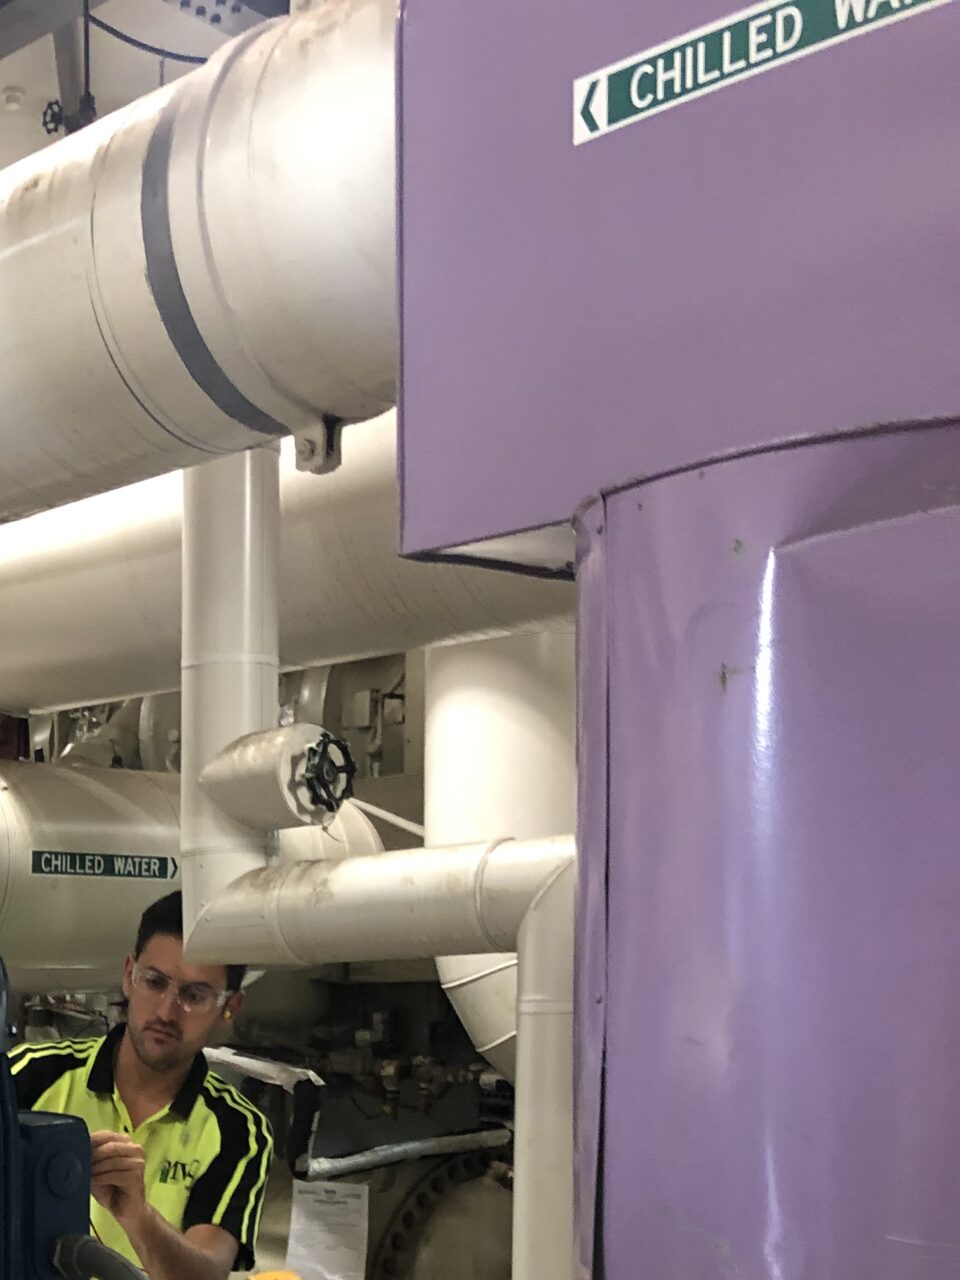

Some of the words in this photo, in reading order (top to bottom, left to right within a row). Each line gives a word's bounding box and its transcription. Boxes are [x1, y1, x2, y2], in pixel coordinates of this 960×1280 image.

[630, 5, 804, 108] CHILLED
[41, 853, 104, 875] CHILLED
[113, 857, 159, 877] WATER
